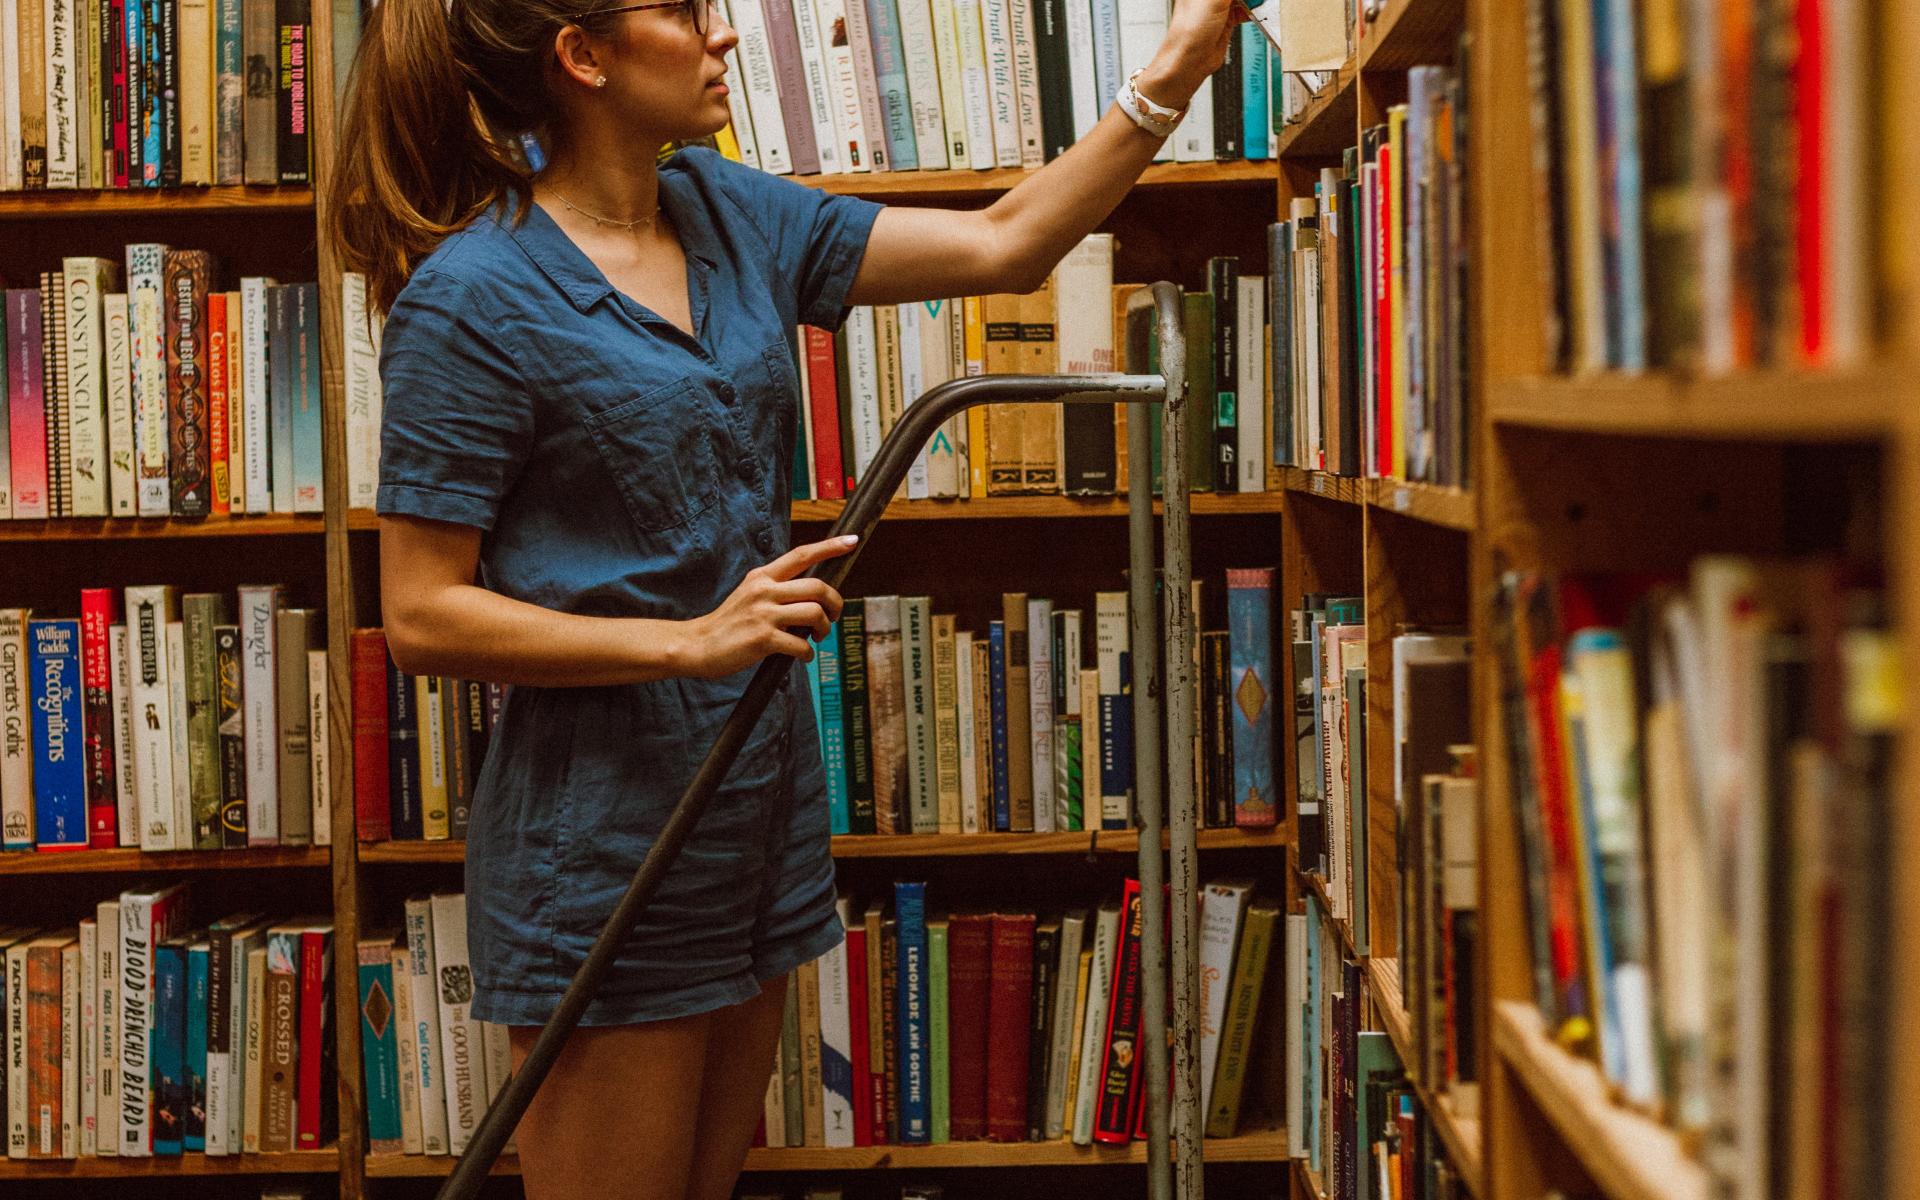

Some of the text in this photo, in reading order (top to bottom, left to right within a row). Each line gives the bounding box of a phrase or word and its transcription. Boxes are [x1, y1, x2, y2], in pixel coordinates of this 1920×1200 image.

[164, 2, 175, 86] Slaughters Braves
[224, 40, 234, 76] Sanford
[291, 25, 303, 40] THE
[292, 42, 304, 65] ROAD
[1102, 13, 1114, 80] DANGEROUS
[129, 11, 138, 165] COLUMBUS SLAUGHTERS BRAVES
[292, 67, 304, 80] TO
[988, 2, 1010, 124] Drunk With Love
[1013, 2, 1034, 125] Drunk With Love
[837, 56, 859, 132] RHODA
[887, 89, 905, 142] Gilchrist
[927, 107, 938, 128] Ellen
[70, 278, 90, 426] CONSTANCIA
[110, 314, 126, 424] CONSTANCIA
[177, 279, 197, 470] DESTINY DESIRE CARLOS FUENTES
[1093, 348, 1114, 362] ONE
[210, 331, 225, 455] CARLOS FUENTES
[246, 287, 259, 480] The Crystal Frontier CARLOS FUENTES
[863, 395, 872, 418] Prime
[146, 411, 158, 460] FUENTES
[215, 466, 228, 499] USED
[36, 625, 71, 640] William
[38, 639, 69, 654] Gaddis
[117, 633, 126, 658] Peter
[140, 609, 155, 680] METROPOLIS
[246, 603, 271, 670] Dangler
[843, 616, 862, 633] THE
[85, 612, 97, 704] ARE SAFEST
[95, 611, 108, 705] JUST WHEN WE
[818, 651, 839, 683] ANNA
[3, 642, 24, 759] Carpenter's Gothic
[37, 659, 69, 763] Recognitions
[62, 687, 72, 702] the
[120, 696, 129, 714] THE
[470, 683, 481, 732] CEMENT
[909, 605, 927, 808] YEARS FROM NOW GARY GLICKMAN
[1033, 660, 1051, 766] FIRST FIG TREE
[94, 735, 103, 786] GADNEY
[121, 718, 131, 761] MYSTERY
[123, 764, 133, 795] ROAST
[1325, 761, 1333, 800] GREENE
[416, 933, 428, 976] Bedford
[1098, 924, 1109, 1000] CLAIRVOYANT
[884, 978, 892, 1035] BURNT
[1125, 975, 1137, 993] THE
[11, 959, 22, 1068] FACING THE TANK
[63, 1007, 70, 1019] IN
[104, 989, 112, 1059] FACES MASKS
[123, 937, 147, 1126] BLOOD-DRENCHED BEARD
[276, 979, 291, 1065] CROSSED
[907, 946, 920, 1103] LEMONADE ANN GOETHE
[1122, 998, 1134, 1028] DEVIL
[63, 1021, 71, 1060] AUGUST
[417, 1021, 431, 1088] Gail Godwin
[806, 1034, 817, 1061] Caleb
[400, 1039, 414, 1112] Caleb Williams
[449, 1007, 473, 1130] THE GOOD HUSBAND
[807, 1067, 819, 1107] Williams
[885, 1040, 895, 1122] OFFERING
[209, 1084, 220, 1121] Gallagher
[278, 1090, 287, 1129] NICOLE
